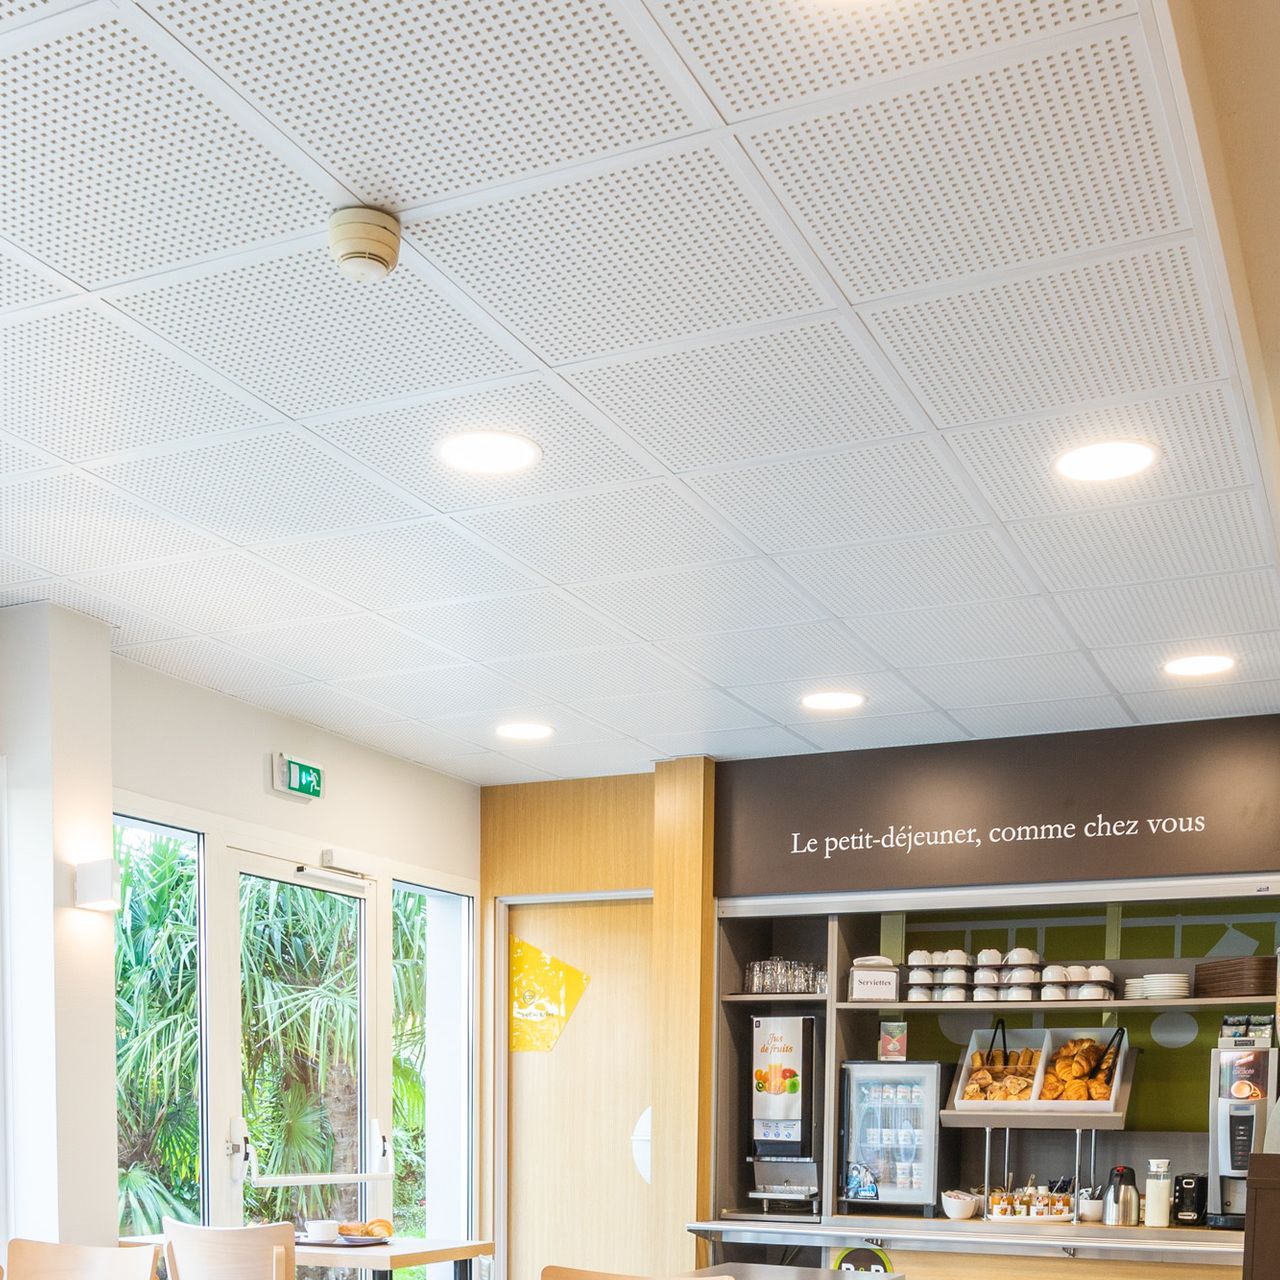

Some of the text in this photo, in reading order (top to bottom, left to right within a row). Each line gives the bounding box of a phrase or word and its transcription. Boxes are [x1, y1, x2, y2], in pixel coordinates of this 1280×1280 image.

[790, 813, 1206, 859] Le petit-déjeuner, comme chez vous
[760, 1044, 793, 1055] de fruits
